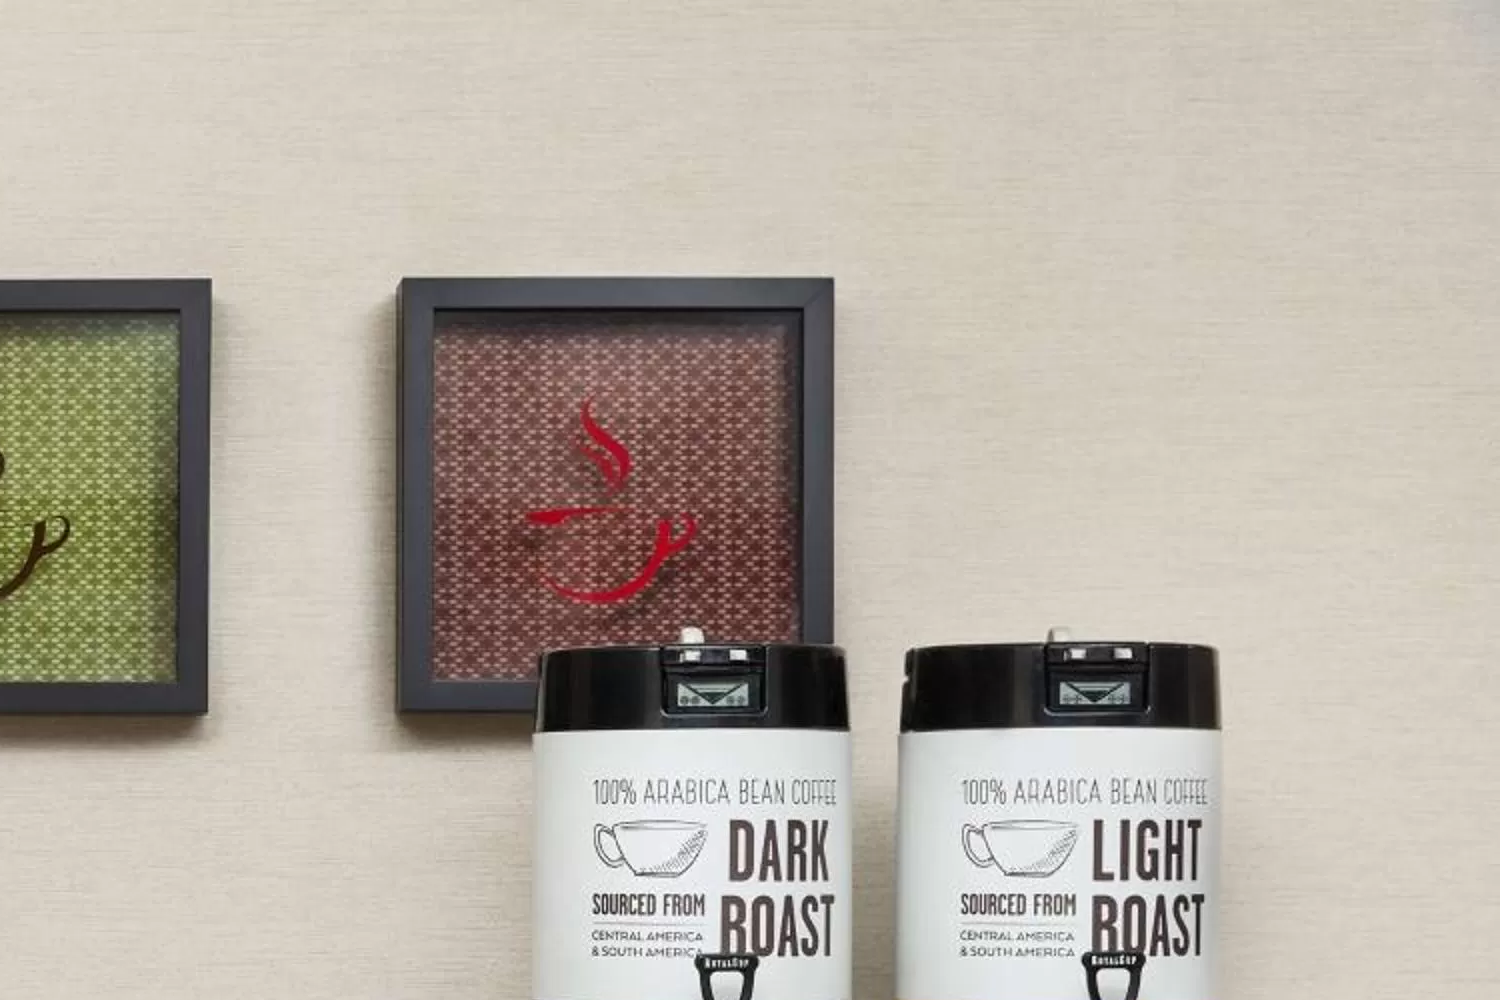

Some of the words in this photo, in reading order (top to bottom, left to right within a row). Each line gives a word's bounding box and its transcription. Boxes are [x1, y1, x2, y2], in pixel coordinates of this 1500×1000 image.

[593, 779, 637, 805] 100%
[643, 779, 731, 805] ARABICA
[739, 779, 785, 805] BEAN
[791, 779, 837, 805] COFFEE
[962, 779, 1007, 805] 100%
[1013, 779, 1102, 805] ARABICA
[1111, 779, 1157, 805] BEAN
[1164, 779, 1208, 805] COFFEE
[729, 819, 829, 882] DARK
[1093, 819, 1202, 881] LIGHT
[592, 893, 656, 916] SOURCED
[663, 894, 705, 916] FROM
[961, 893, 1026, 916] SOURCED
[1033, 893, 1077, 916] FROM
[591, 930, 644, 941] CENTRAL
[646, 931, 703, 941] AMERICA
[720, 894, 835, 957] ROAST
[960, 929, 1013, 941] CENTRAL
[1016, 931, 1075, 941] AMERICA
[1091, 894, 1205, 957] ROAST
[591, 945, 599, 957] &
[602, 946, 643, 957] SOUTH
[960, 945, 968, 957] &
[970, 946, 1013, 957] SOUTH
[1015, 947, 1075, 957] AMERICA
